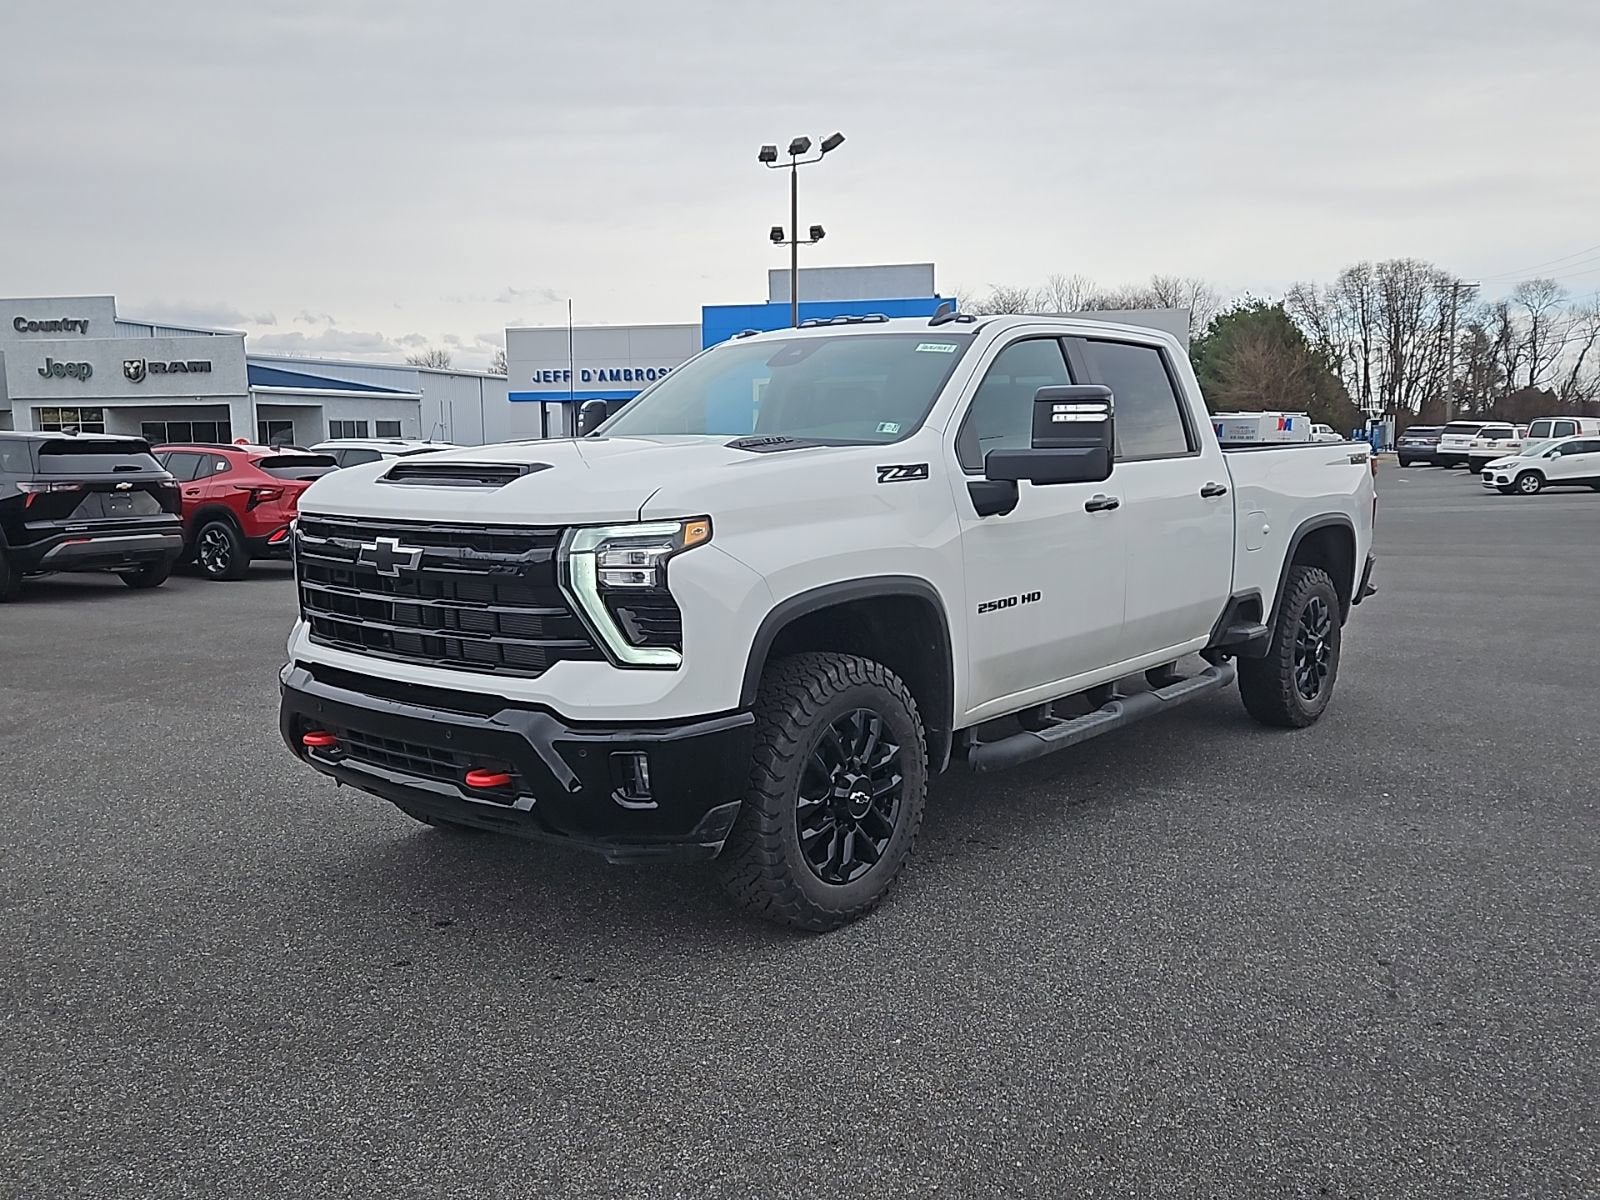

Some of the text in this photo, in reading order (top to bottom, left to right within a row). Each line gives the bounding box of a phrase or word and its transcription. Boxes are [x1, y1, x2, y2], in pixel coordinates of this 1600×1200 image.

[14, 317, 89, 334] Country
[38, 358, 93, 382] Jeep
[149, 361, 212, 374] RAM
[533, 367, 674, 383] JEFF D'AMBROS
[978, 591, 1041, 614] 2500 HD
